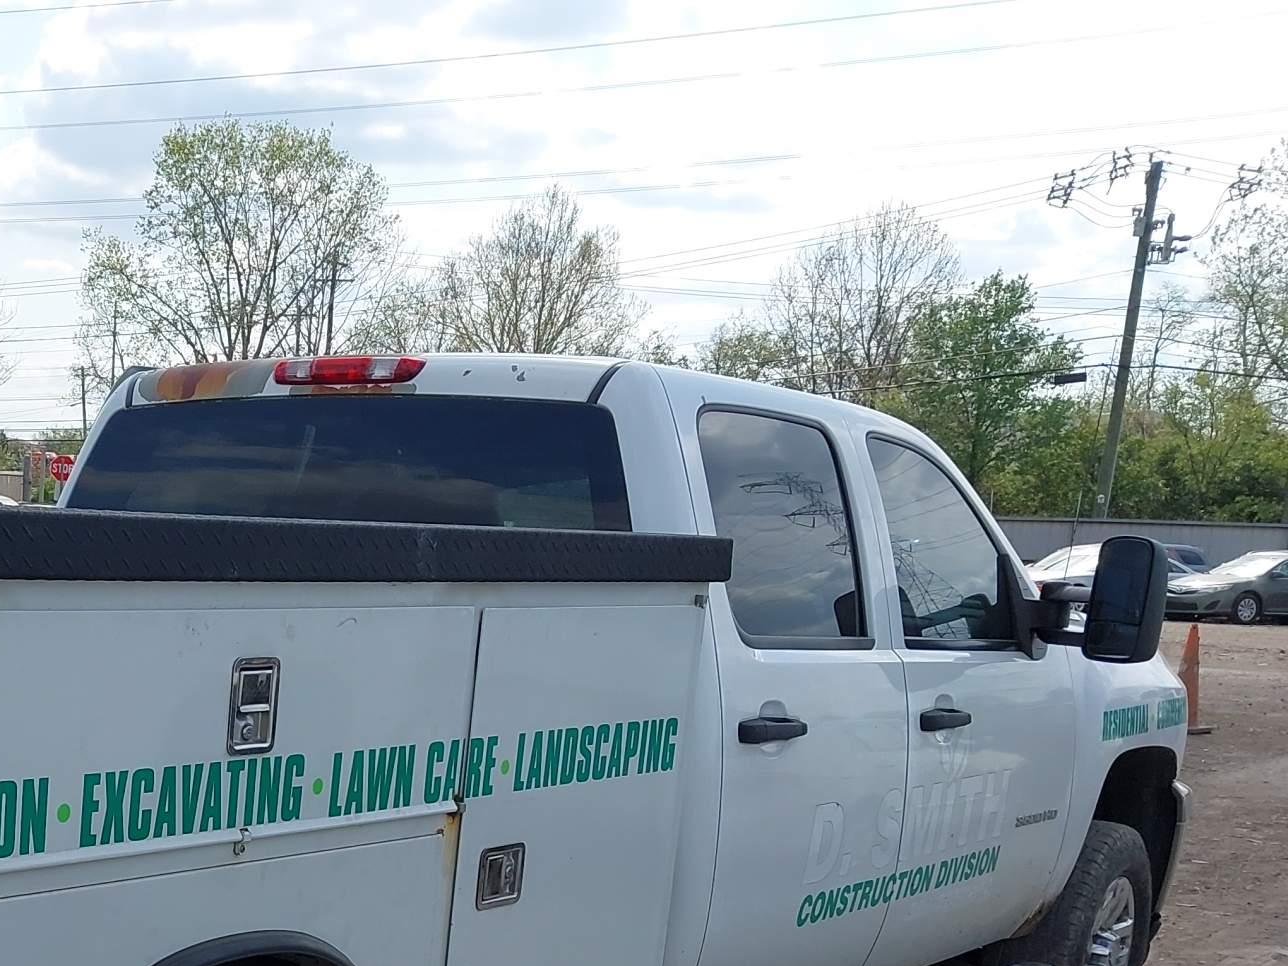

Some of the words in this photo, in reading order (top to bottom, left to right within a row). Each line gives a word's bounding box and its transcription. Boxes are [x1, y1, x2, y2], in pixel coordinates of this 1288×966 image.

[79, 753, 306, 848] EXCAVATING
[328, 744, 416, 818] LAWN
[423, 735, 499, 804] CARE
[512, 717, 679, 792] LANDSCAPING
[796, 864, 936, 928] CONSTRUCTION
[934, 845, 1002, 890] DIVISION
